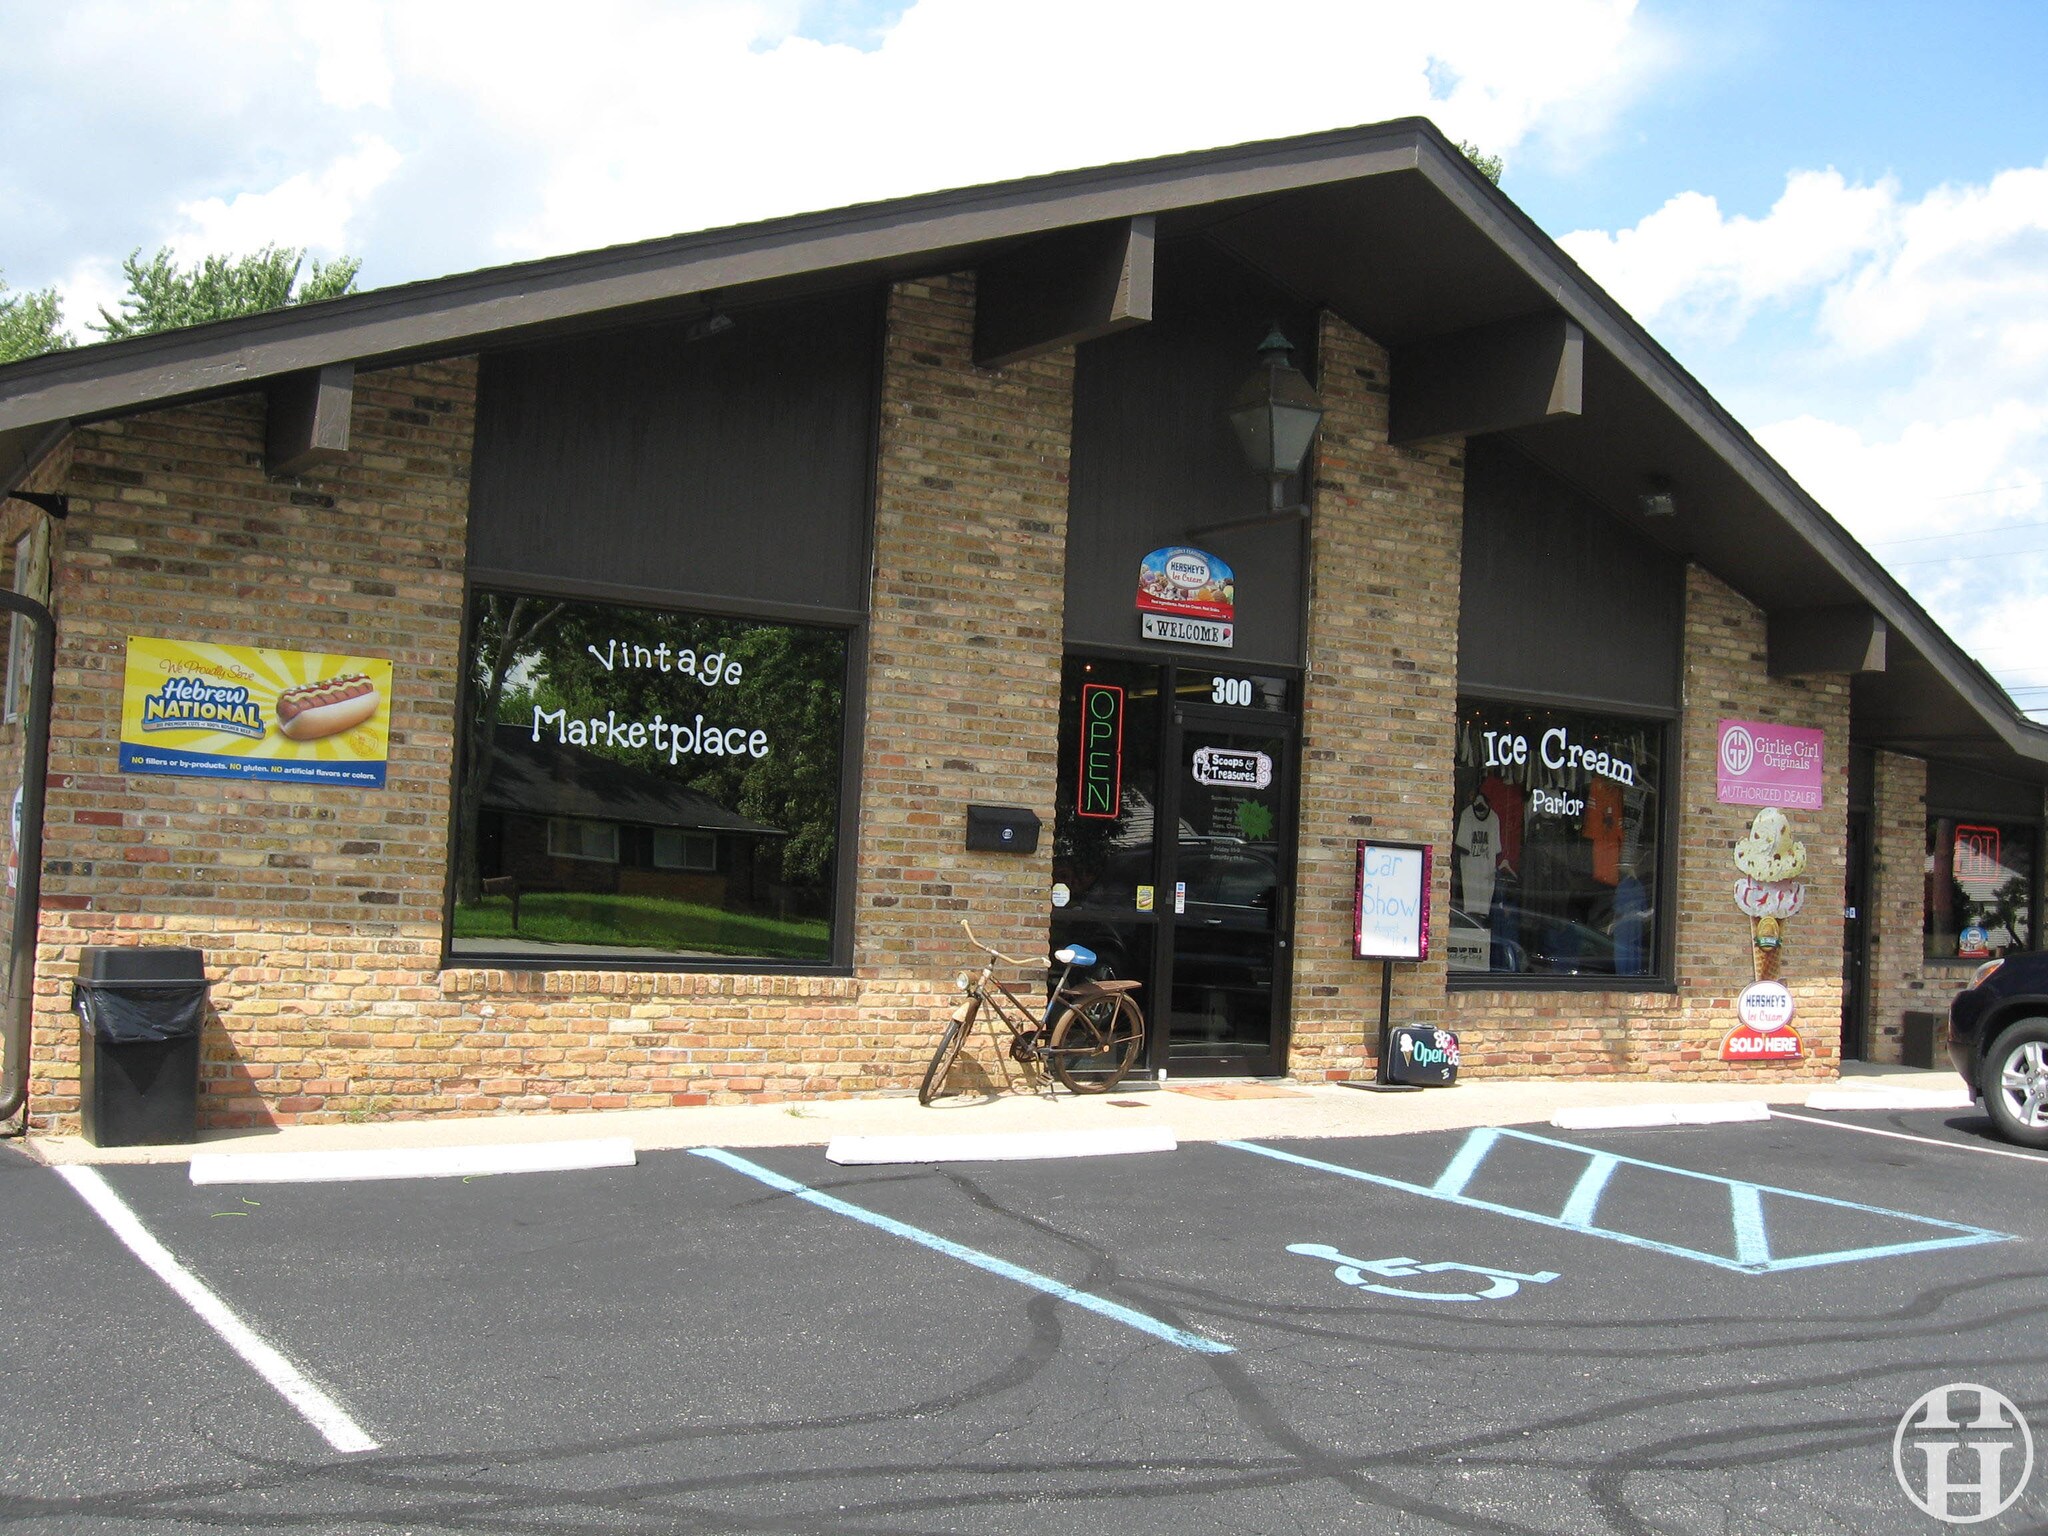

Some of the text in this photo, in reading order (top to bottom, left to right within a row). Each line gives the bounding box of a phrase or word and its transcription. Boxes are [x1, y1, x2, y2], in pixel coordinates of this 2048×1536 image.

[1171, 562, 1205, 575] HERSHEY'S
[1157, 621, 1219, 642] WELCOME
[159, 659, 255, 680] We Proudly Serve
[588, 639, 742, 686] Vintage
[165, 680, 246, 704] Hebrew
[1212, 676, 1252, 706] 300
[148, 698, 259, 728] NATIONAL
[532, 705, 769, 765] Marketplace
[1087, 691, 1115, 811] OPEN
[1483, 727, 1634, 786] Ice Cream
[1755, 737, 1819, 758] Girlie Girl
[131, 756, 144, 764] NO
[145, 758, 167, 766] fillers
[180, 760, 227, 770] by-products.
[284, 767, 314, 775] artificial
[316, 769, 340, 777] flavors
[351, 772, 376, 780] colors.
[1211, 767, 1255, 781] Treasures
[1212, 754, 1255, 770] Scoops &
[1764, 753, 1810, 771] Originals
[1532, 788, 1584, 816] Parlor
[1721, 785, 1817, 804] AUTHORIZED DEALER
[1365, 847, 1402, 876] Car
[1363, 883, 1418, 917] Show
[1746, 994, 1786, 1008] HERSHEY'S
[1748, 1010, 1783, 1022] Ice Cream
[1413, 1040, 1447, 1067] Open
[1729, 1037, 1797, 1053] SOLD HERE
